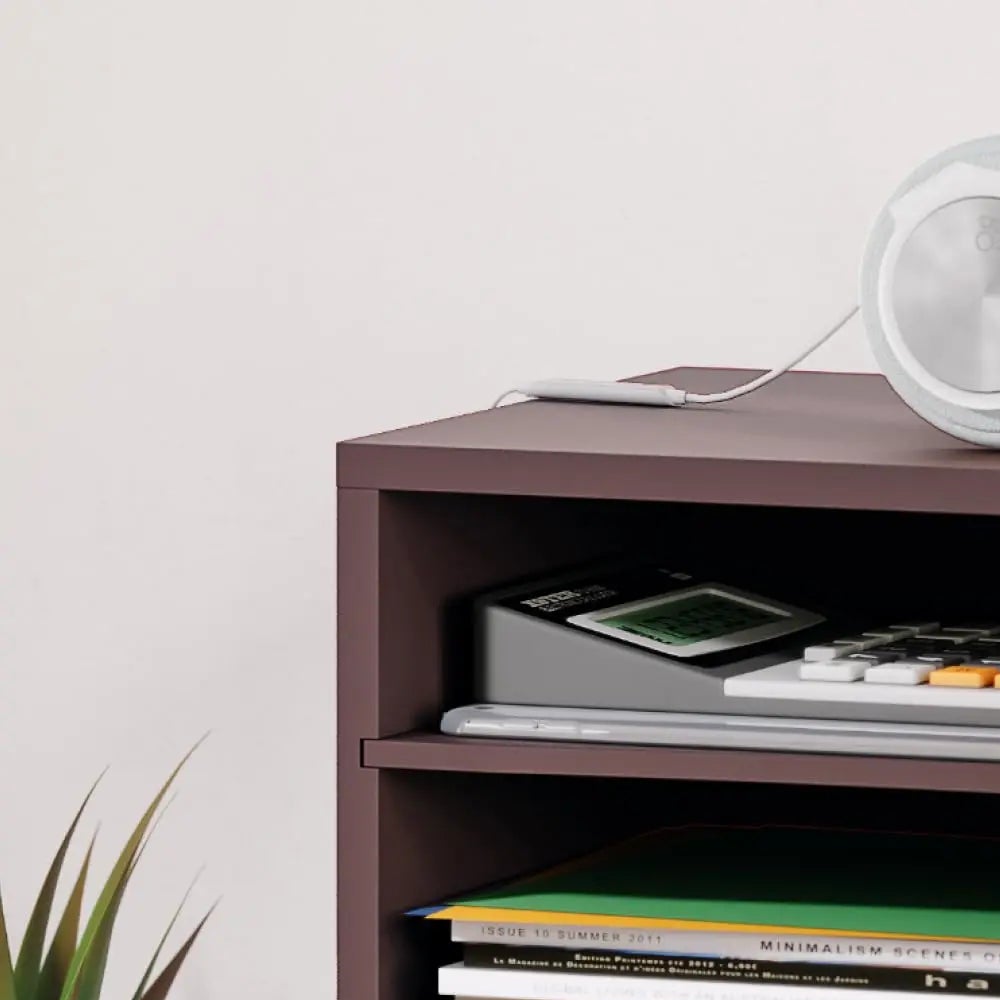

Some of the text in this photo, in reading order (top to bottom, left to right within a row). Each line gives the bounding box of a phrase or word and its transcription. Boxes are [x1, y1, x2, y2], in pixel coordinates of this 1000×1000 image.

[481, 926, 662, 945] ISSUE 10 SUMMER 2011
[760, 940, 882, 957] MINIMALISM
[893, 946, 972, 962] SCENES
